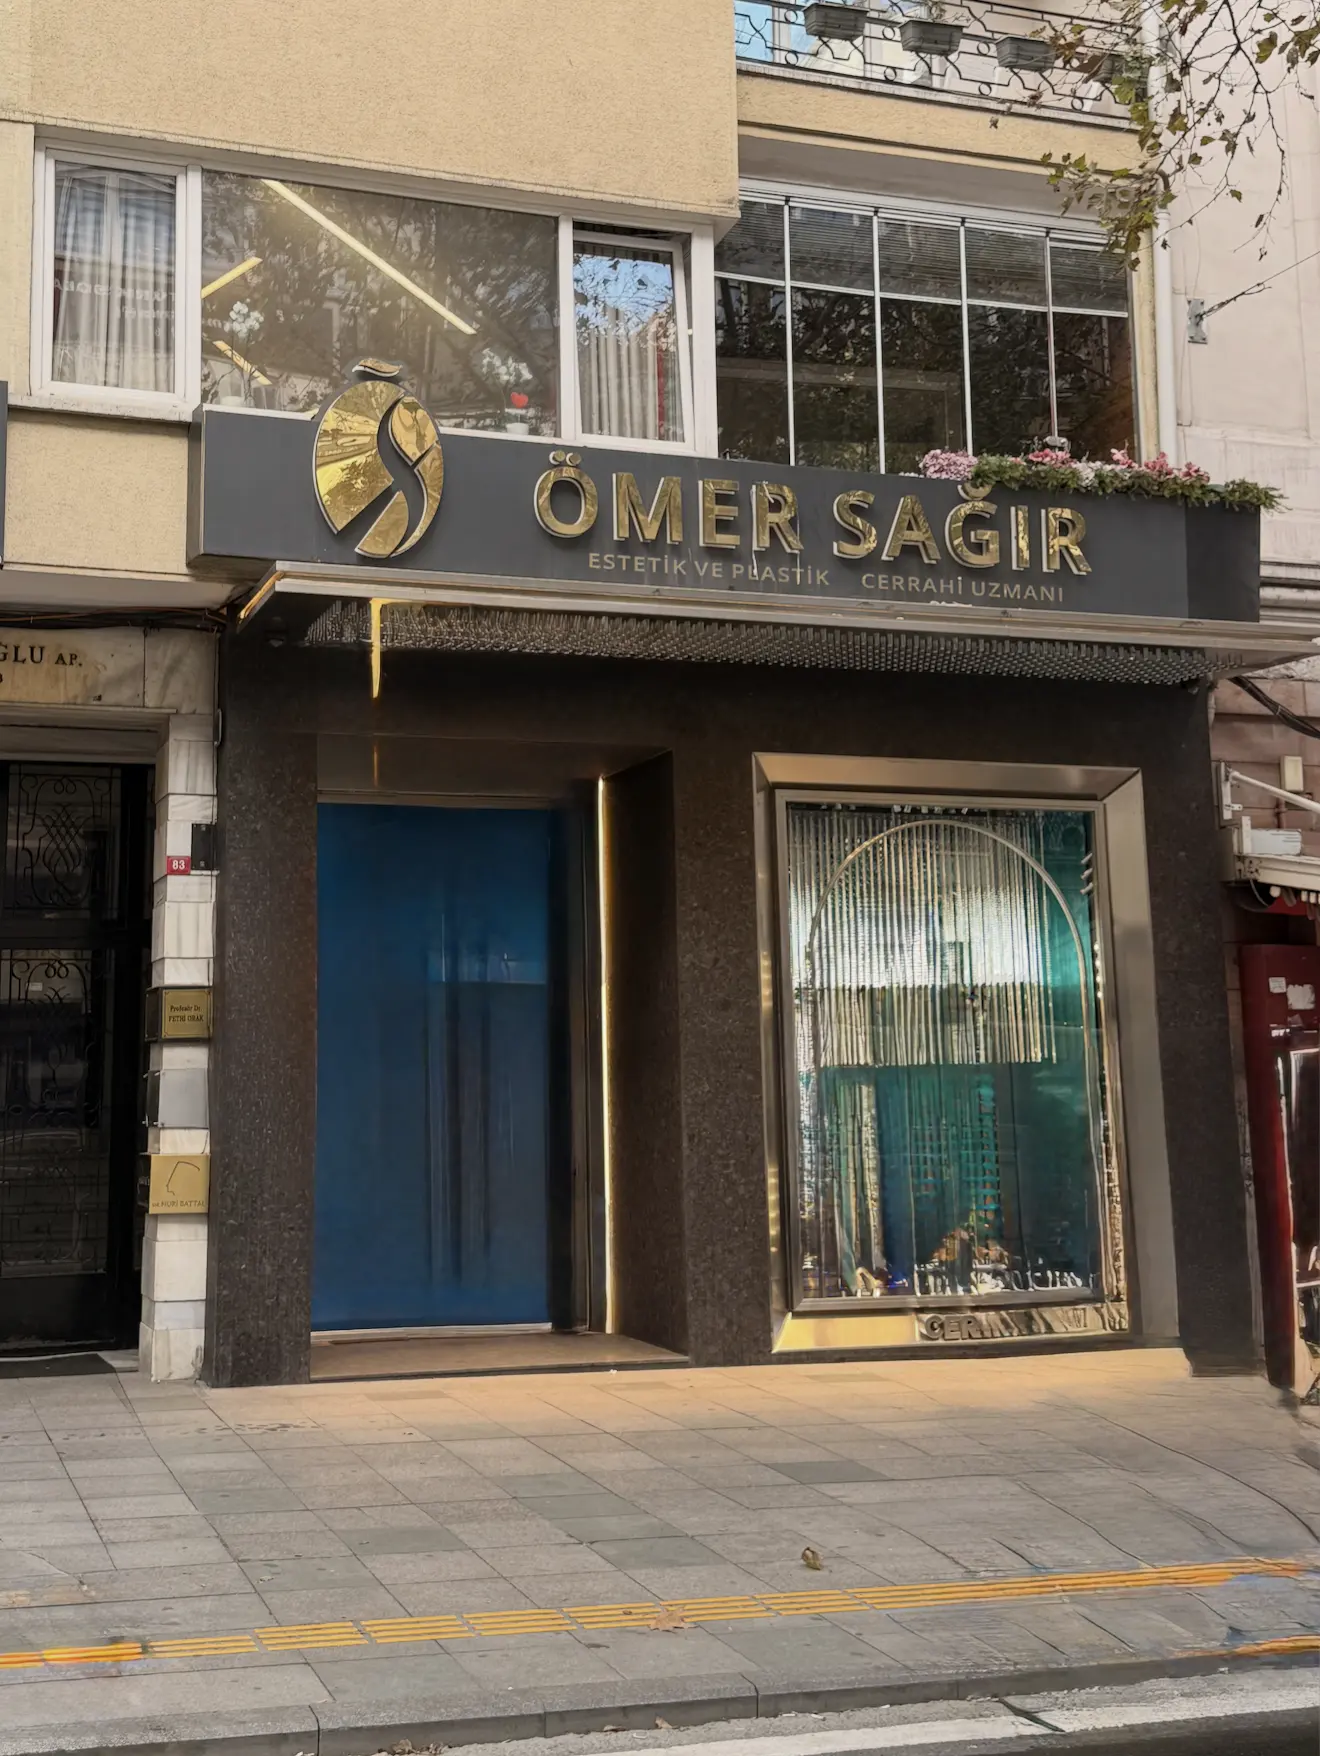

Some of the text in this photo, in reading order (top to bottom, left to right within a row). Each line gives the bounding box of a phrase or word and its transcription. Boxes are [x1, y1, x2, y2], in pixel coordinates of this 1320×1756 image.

[534, 451, 1092, 575] ÖMER SAĞIR
[589, 552, 1063, 602] ESTETİK VE PLASTİK CERRAHİ UZMANI
[172, 859, 185, 870] 83
